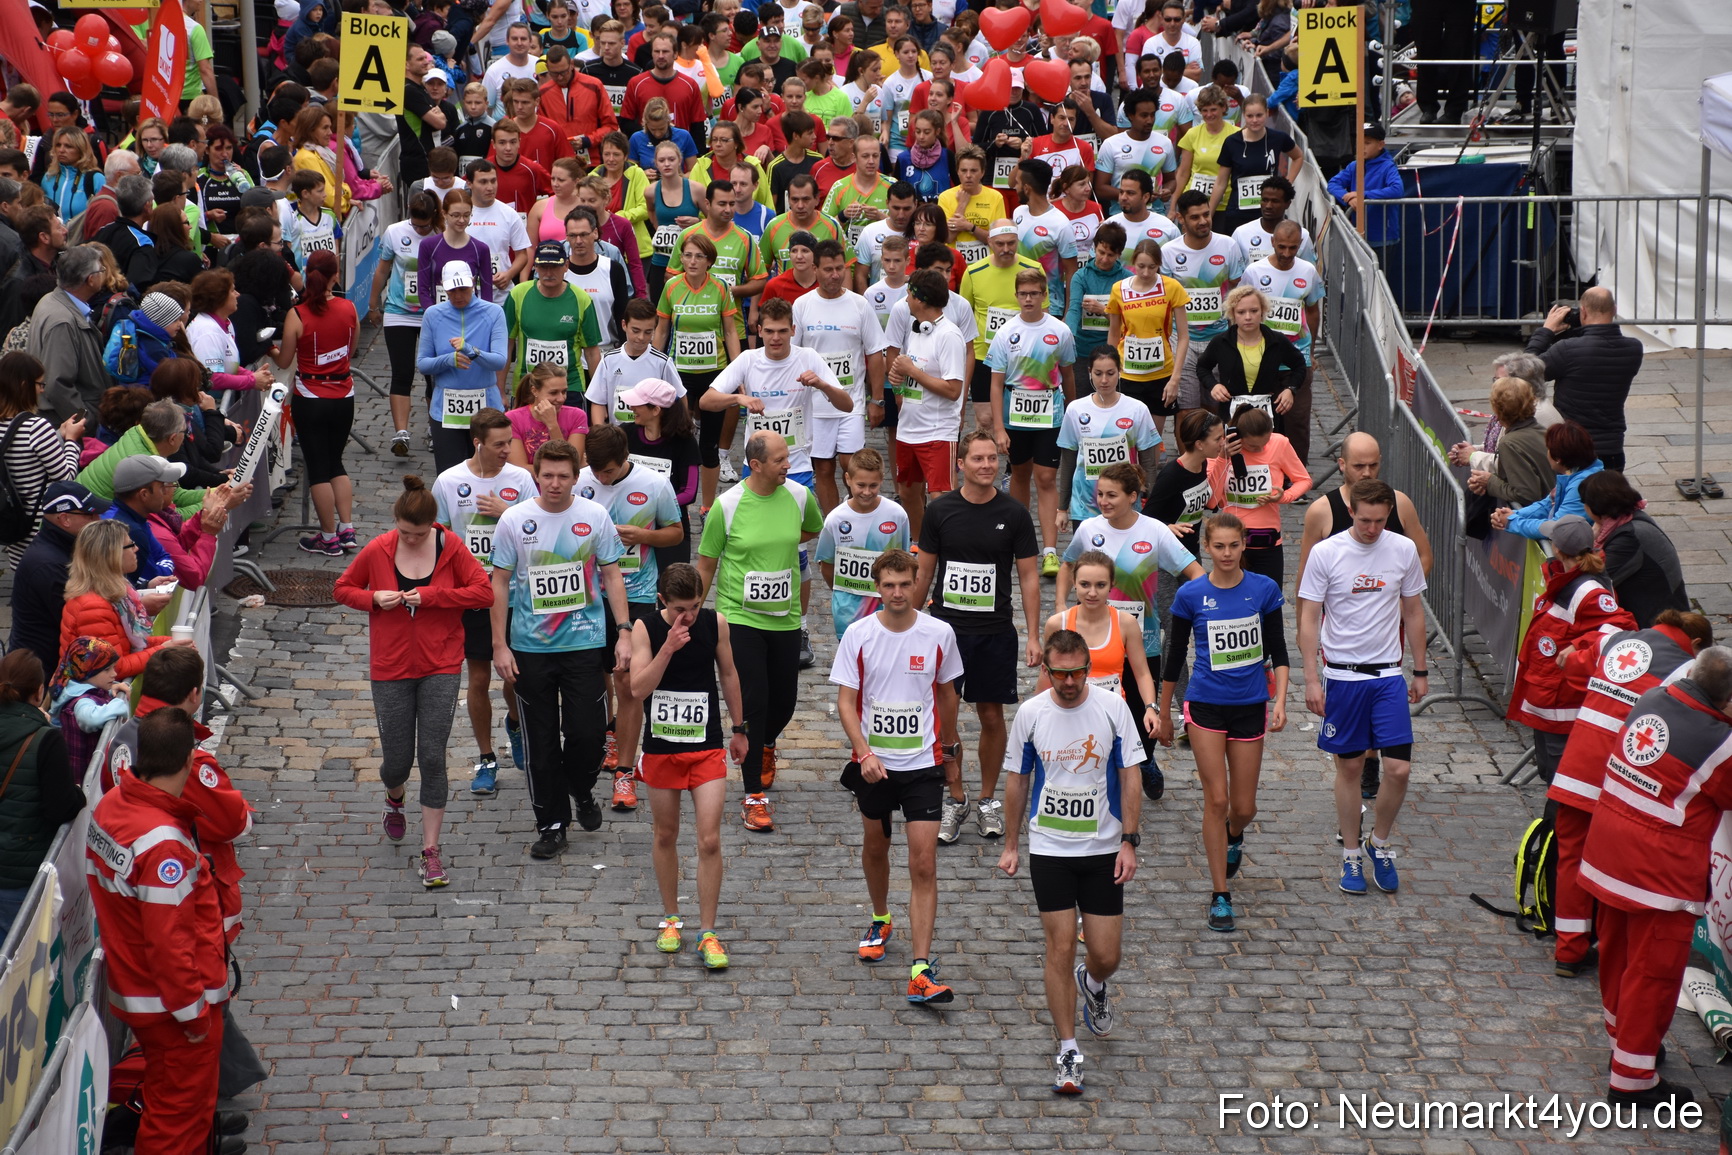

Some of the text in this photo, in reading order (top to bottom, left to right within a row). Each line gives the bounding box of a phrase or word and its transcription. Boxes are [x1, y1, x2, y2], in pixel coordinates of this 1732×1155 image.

[350, 17, 401, 39] Block
[1306, 11, 1357, 31] Block
[1312, 37, 1351, 85] A
[353, 45, 391, 93] A
[713, 92, 731, 108] 306
[905, 165, 915, 177] 8
[1194, 181, 1215, 195] 515
[1242, 183, 1262, 197] 515
[655, 232, 678, 246] 500
[960, 246, 988, 262] 5310
[673, 304, 718, 315] BOCK
[1124, 298, 1168, 310] MAX BÖGL
[1186, 297, 1219, 311] 5333
[680, 341, 713, 355] 5200
[1127, 346, 1160, 361] 5174
[530, 349, 564, 365] 5023
[829, 361, 851, 376] 178
[448, 399, 481, 414] 5341
[1015, 398, 1049, 414] 5007
[754, 419, 790, 436] 5197
[232, 409, 272, 483] BMW Laufsport
[1089, 445, 1125, 465] 5026
[1228, 475, 1267, 493] 5092
[471, 537, 491, 554] 50
[836, 550, 852, 558] PARTL
[529, 566, 575, 577] PARTL Neumarkt
[764, 574, 786, 582] Neumarkt
[536, 573, 580, 597] 5070
[844, 578, 871, 591] Dominik
[949, 573, 992, 593] 5158
[1353, 575, 1383, 589] SGT
[750, 582, 789, 600] 5320
[542, 597, 577, 608] Alexander
[959, 596, 977, 605] Marc
[571, 611, 584, 620] 16.
[1209, 621, 1255, 632] PARTL Neumarkt
[1215, 627, 1259, 652] 5000
[1226, 652, 1252, 663] Samira
[1616, 640, 1649, 664] DEUTSCHES
[1618, 667, 1644, 680] KREUZ
[653, 694, 701, 704] PARTL Neumarkt
[657, 703, 705, 724] 5146
[871, 705, 915, 714] PARTL Neumarkt
[662, 726, 695, 738] Christoph
[873, 714, 919, 736] 5309
[1636, 717, 1665, 744] DEUTSCHES
[1626, 732, 1661, 763] ROTES KREUZ
[1041, 751, 1055, 762] 11.
[1055, 754, 1084, 763] FunRun
[1608, 757, 1659, 794] Sanitätsdienst
[1043, 786, 1060, 796] PARTL
[1044, 795, 1094, 818] 5300
